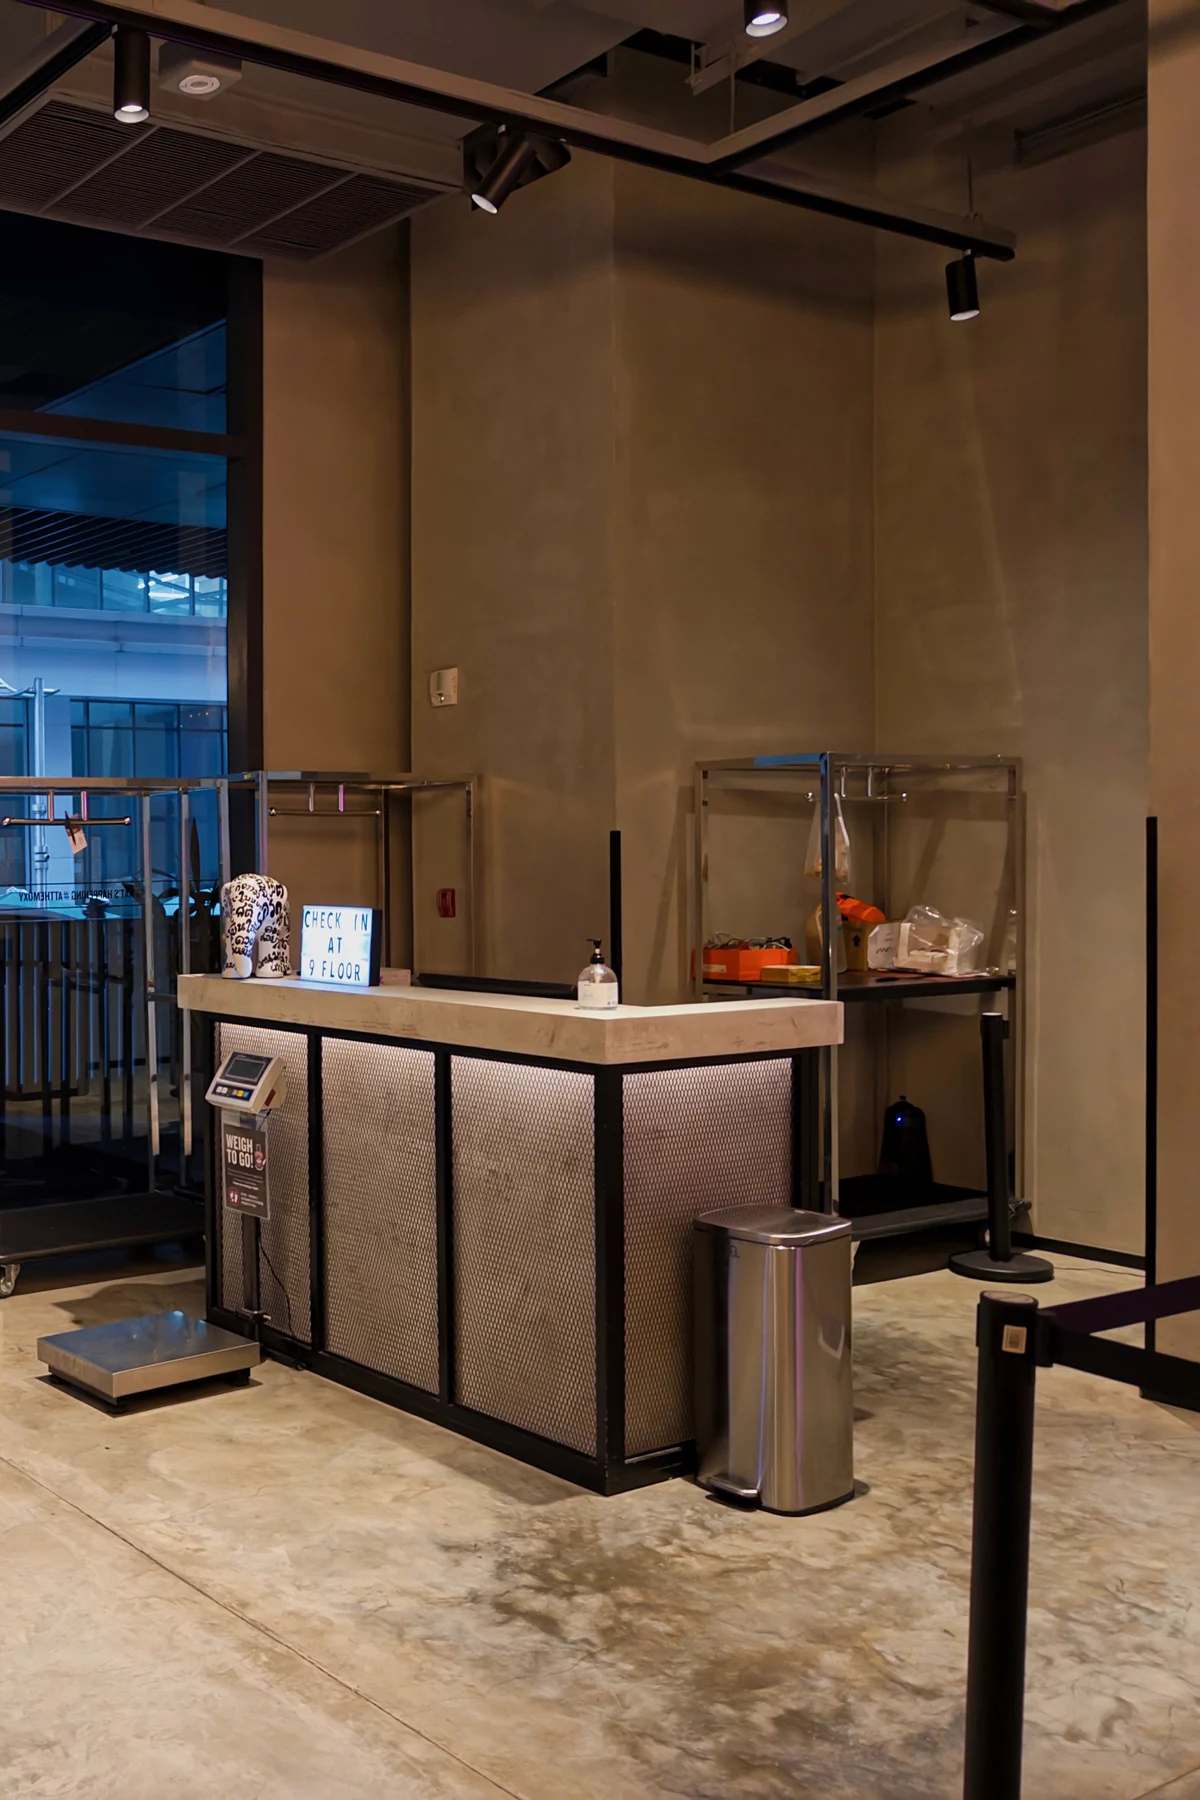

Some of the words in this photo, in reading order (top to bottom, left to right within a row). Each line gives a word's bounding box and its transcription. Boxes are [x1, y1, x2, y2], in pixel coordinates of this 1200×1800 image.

[304, 910, 342, 930] CHECK
[354, 913, 369, 931] IN
[327, 936, 343, 954] AT
[309, 958, 315, 977] 9
[321, 960, 361, 982] FLOOR
[225, 1133, 253, 1154] WEIGH
[226, 1149, 238, 1166] TO
[239, 1151, 254, 1169] GO!
